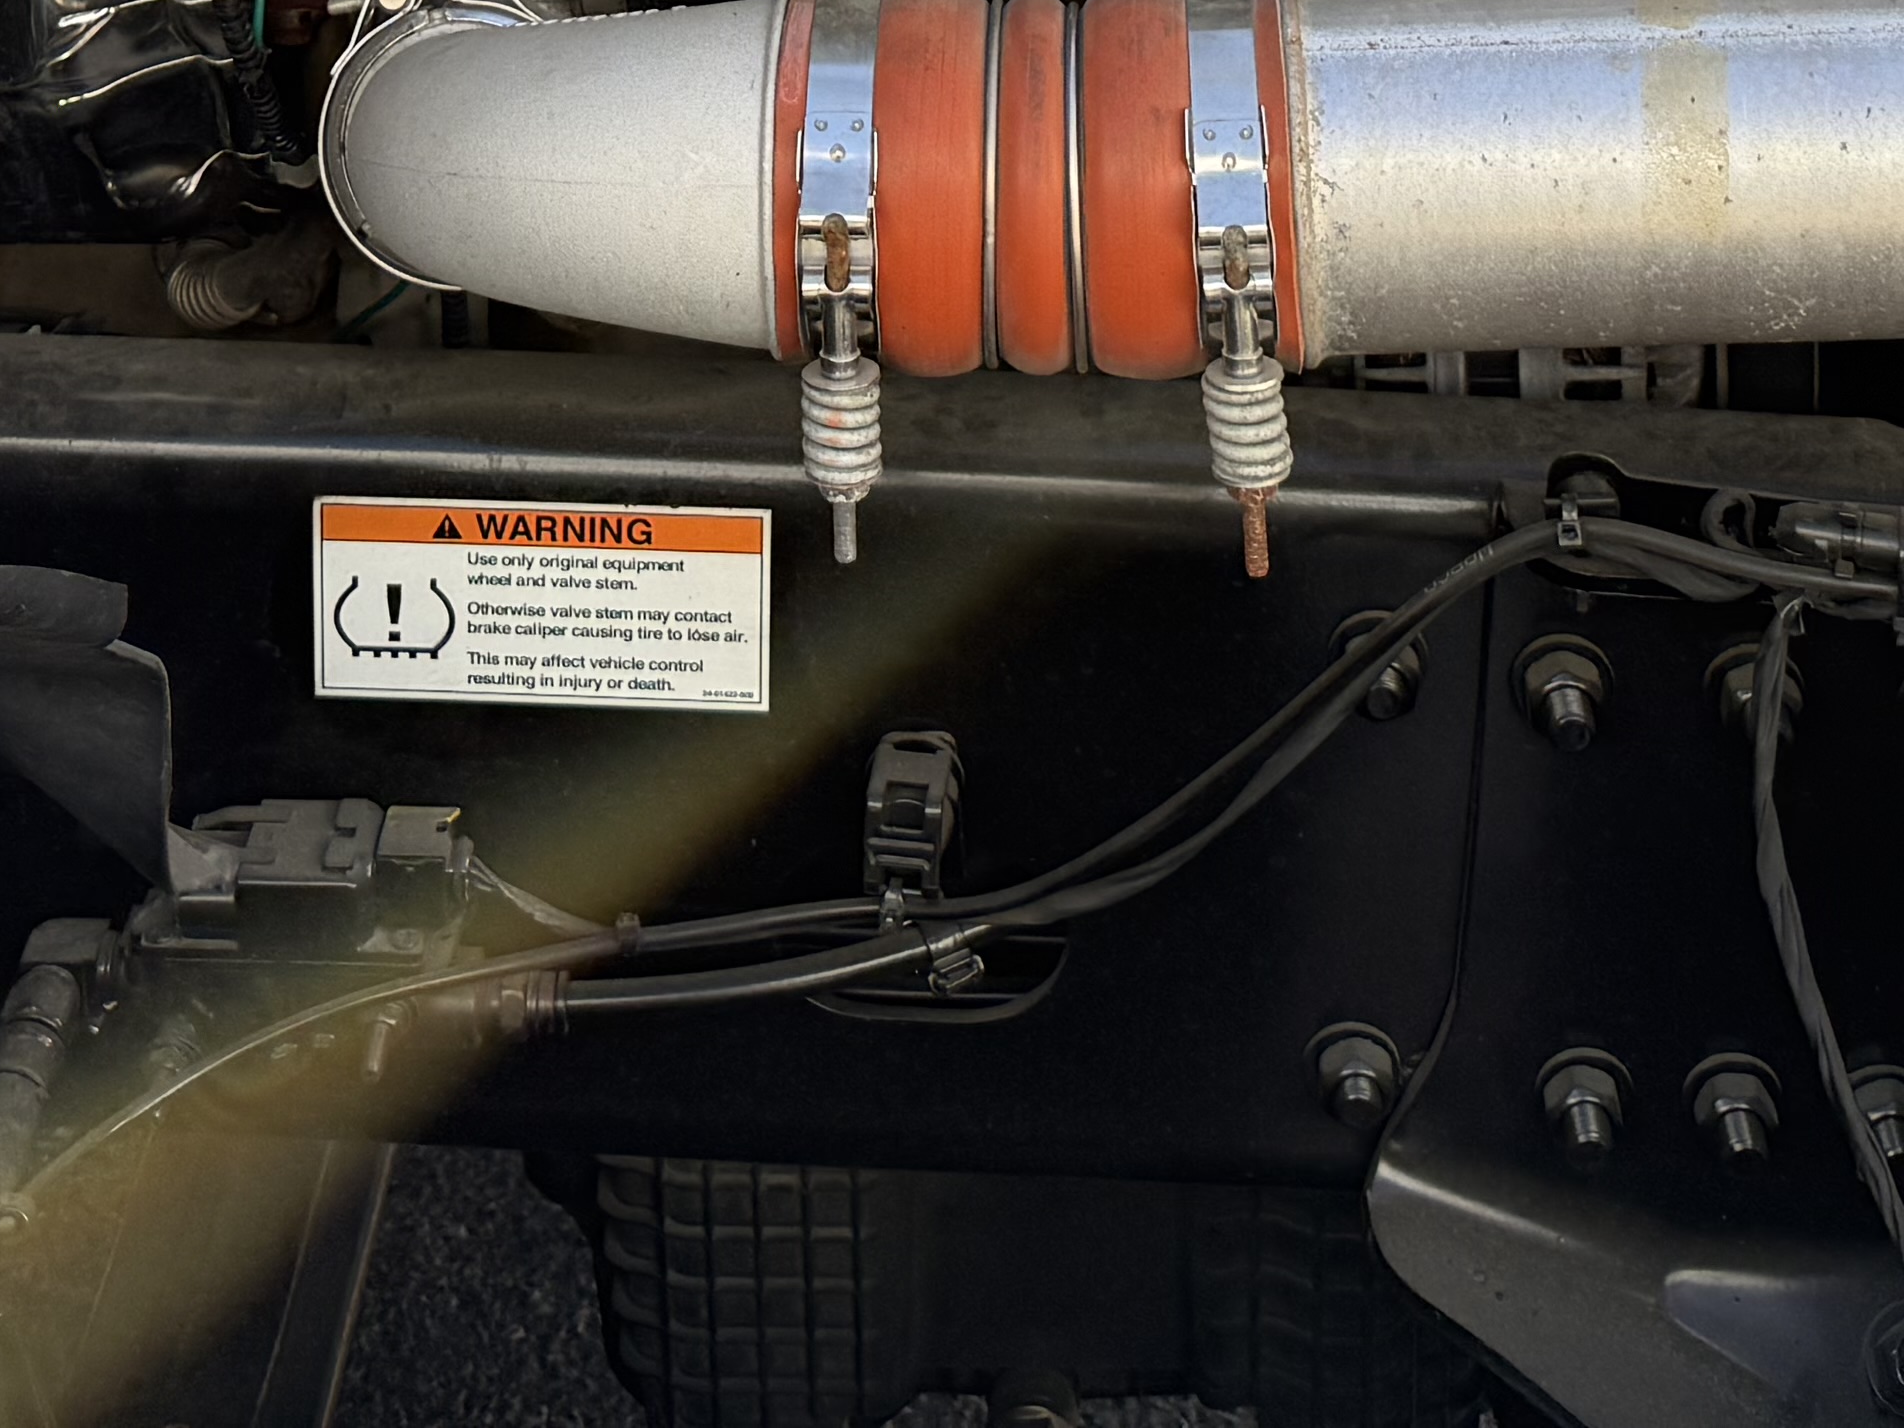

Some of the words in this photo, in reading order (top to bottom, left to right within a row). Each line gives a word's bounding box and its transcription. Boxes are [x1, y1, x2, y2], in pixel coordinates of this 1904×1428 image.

[476, 512, 654, 546] WARNING
[467, 551, 498, 568] Use
[501, 552, 534, 572] only
[539, 554, 598, 572] original
[602, 557, 685, 575] equipment
[467, 572, 512, 587] wheel
[515, 573, 546, 588] and
[550, 575, 592, 590] valve
[595, 576, 638, 591] stem.
[467, 602, 546, 619] Otherwise
[550, 604, 592, 620] valve
[595, 607, 633, 622] stem
[637, 610, 671, 626] may
[674, 609, 733, 625] contact
[467, 621, 512, 636] brake
[514, 622, 568, 639] caliper
[571, 625, 633, 642] causing
[637, 626, 664, 641] tire
[667, 627, 683, 642] to
[686, 626, 721, 643] lose
[724, 628, 749, 644] air.
[467, 651, 500, 667] This
[503, 656, 538, 671] may
[541, 654, 586, 670] affect
[589, 656, 645, 671] vehicle
[648, 657, 704, 673] control
[467, 672, 536, 689] resulting
[539, 673, 555, 688] in
[558, 673, 603, 692] injury
[606, 677, 624, 690] or
[627, 677, 676, 692] death.
